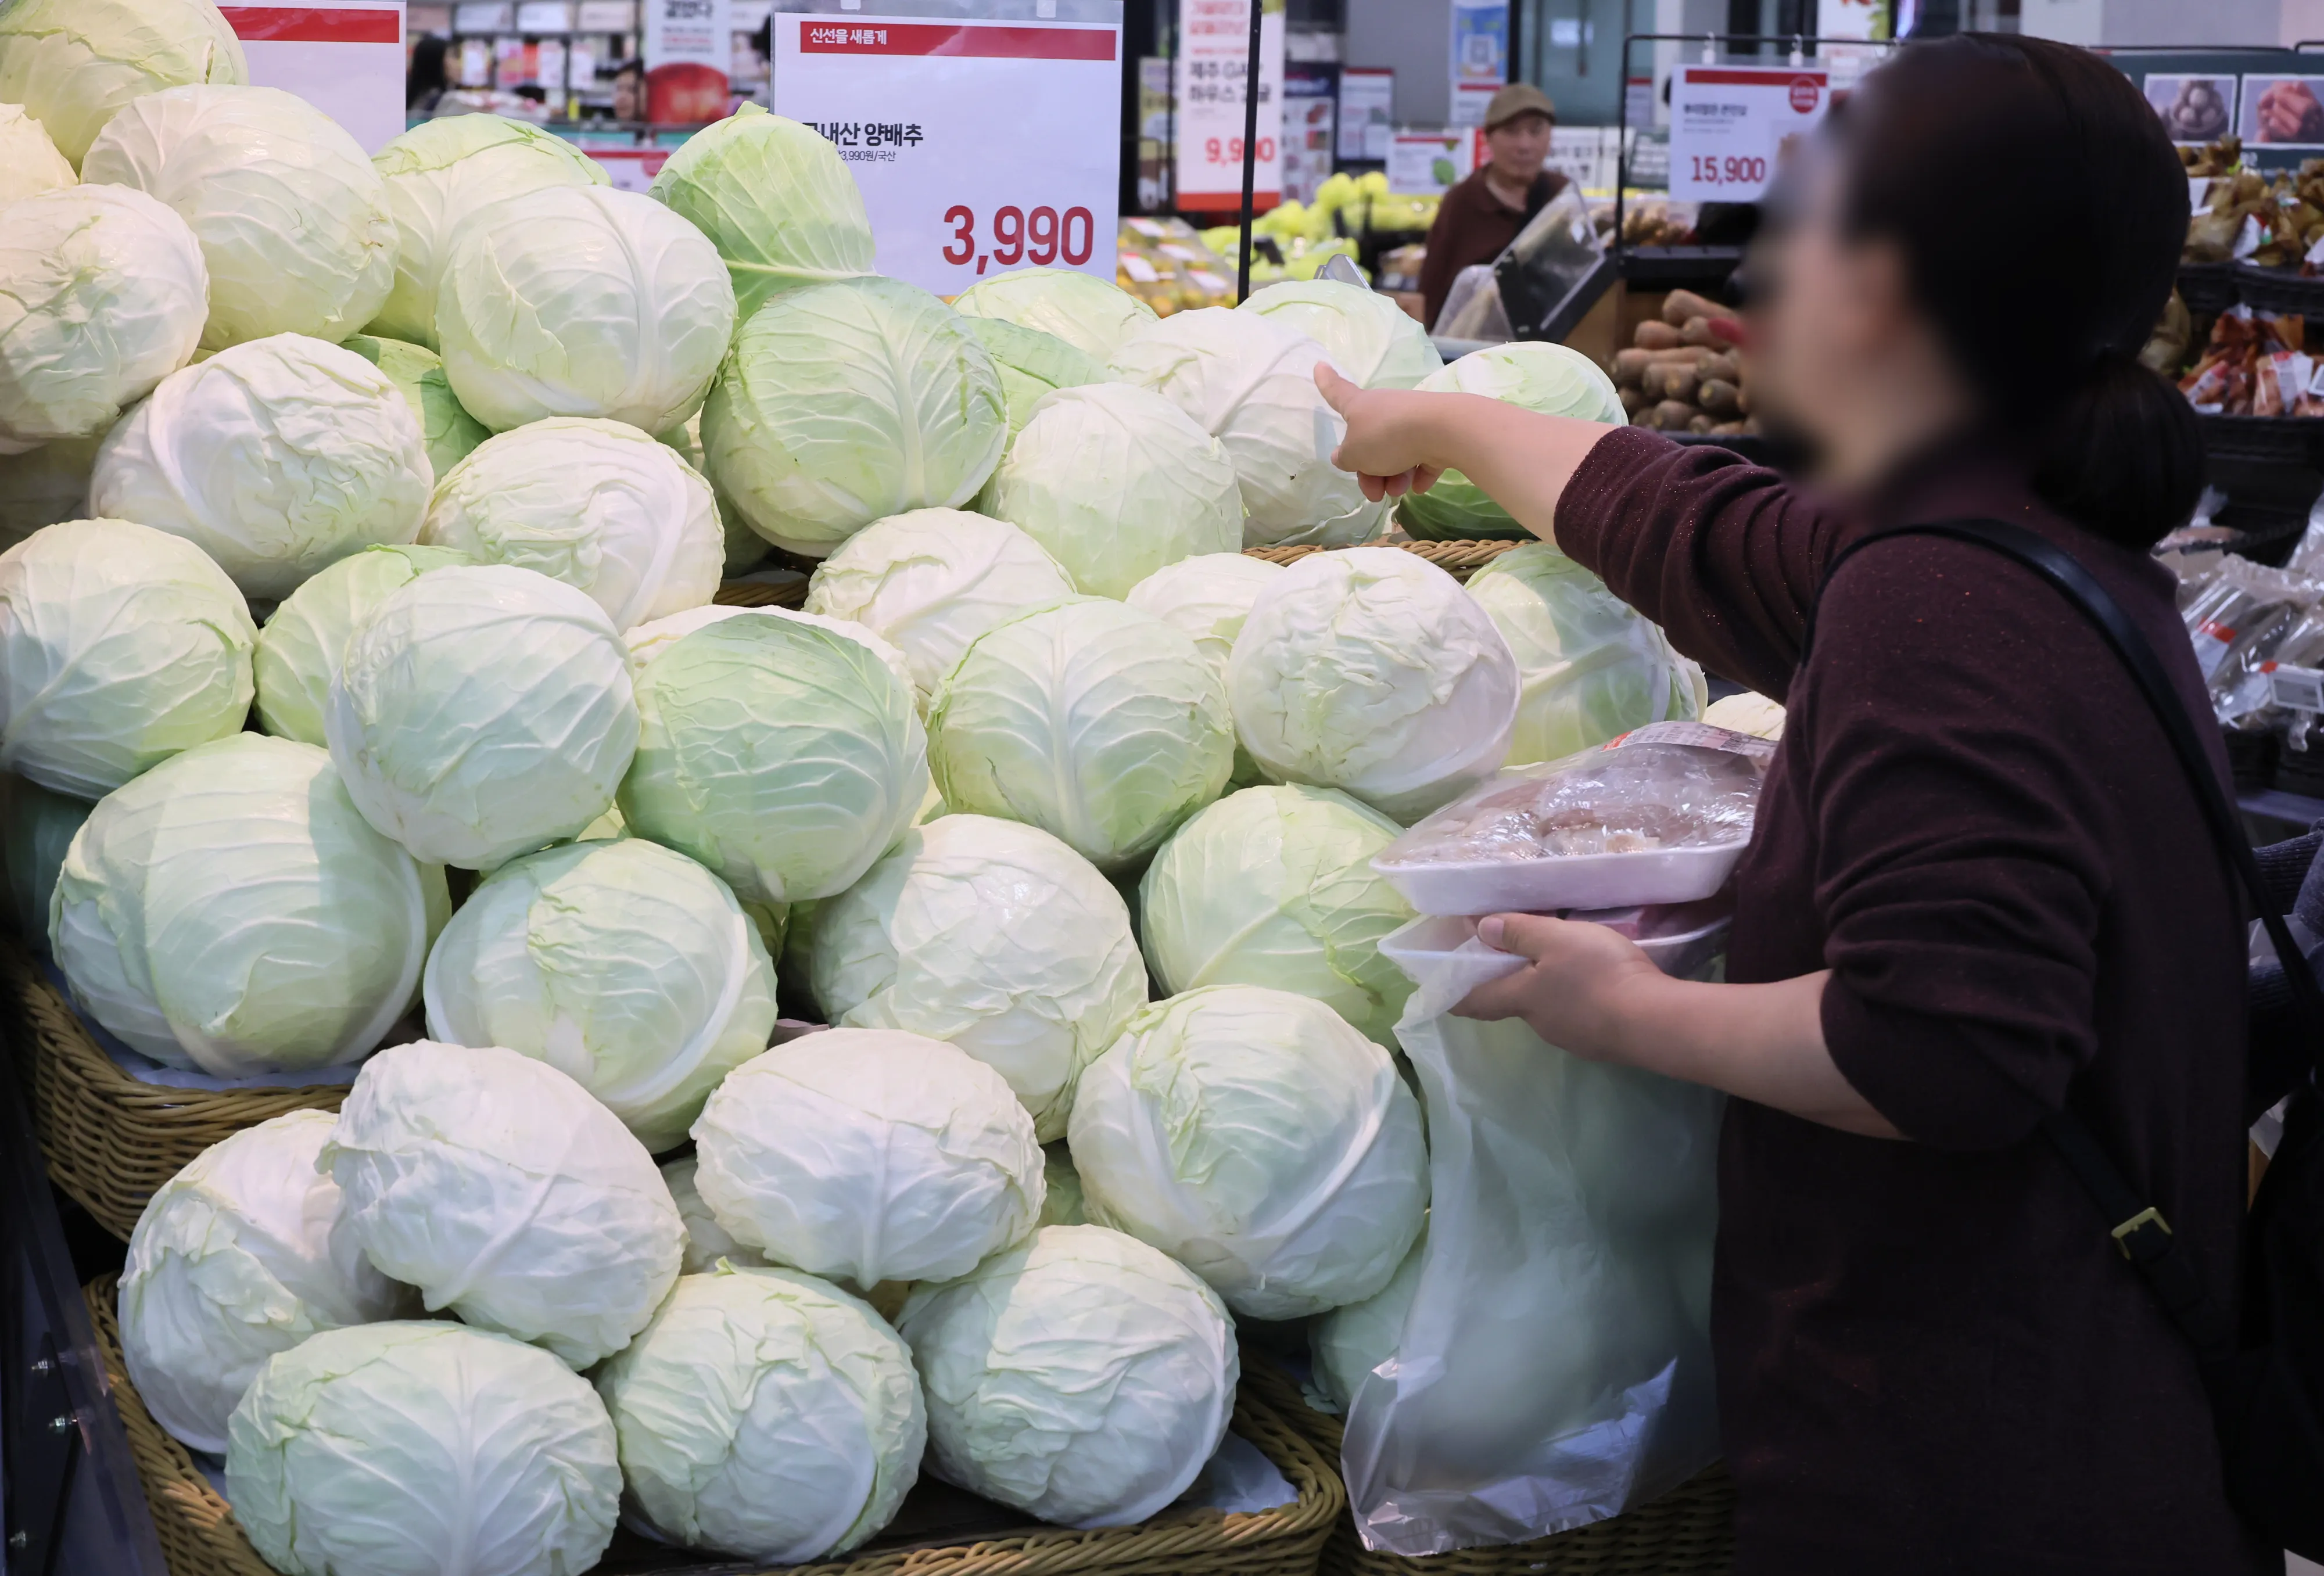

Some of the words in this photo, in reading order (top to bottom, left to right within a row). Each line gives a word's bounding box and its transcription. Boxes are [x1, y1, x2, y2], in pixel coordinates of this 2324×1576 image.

[810, 28, 848, 44] 신선을
[849, 29, 887, 45] 새롭게
[865, 123, 924, 147] 양배추
[1204, 137, 1275, 168] 9,90
[1691, 155, 1766, 186] 15,900
[942, 204, 1094, 275] 3,990
